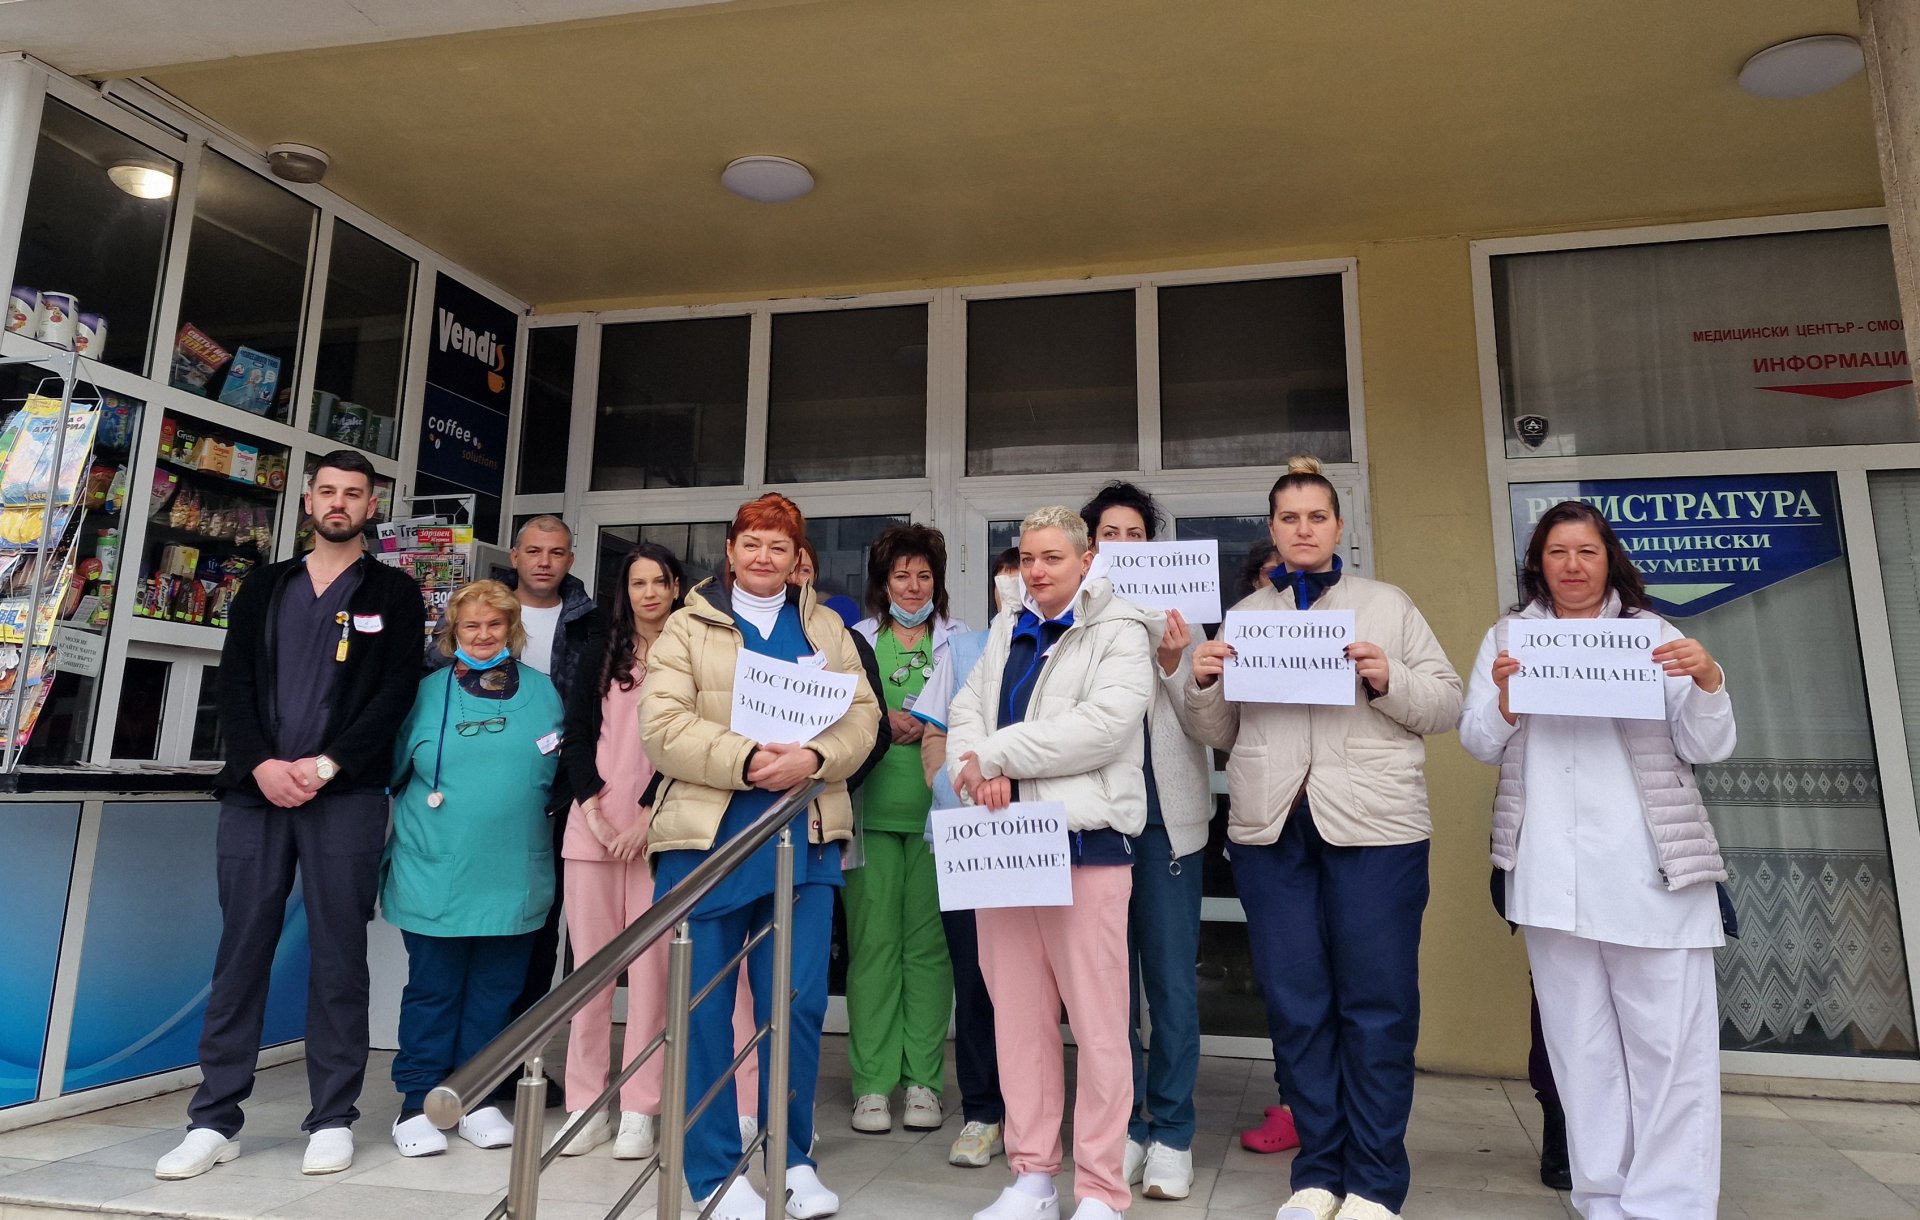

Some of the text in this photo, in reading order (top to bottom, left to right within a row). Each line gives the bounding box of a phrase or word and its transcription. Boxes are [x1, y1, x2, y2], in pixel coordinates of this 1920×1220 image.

[1693, 325, 1790, 343] МЕДИЦИНСКИ
[1753, 350, 1908, 373] ИНФОРМАЦИ
[428, 416, 471, 443] coffee
[461, 449, 499, 471] solutions
[1527, 489, 1822, 523] РИСТРАТУРА
[1619, 533, 1772, 553] ИЦИНСКИ
[1110, 552, 1211, 569] ДОСТОЙНО
[1630, 557, 1762, 573] КУМЕНТИ
[1235, 622, 1346, 640] ДОСТОЙНО
[1521, 631, 1651, 650] ДОСТОЙНО
[1232, 656, 1351, 671] ЗАПЛАЩАНЕ!
[1518, 665, 1657, 682] ЗАПЛАЩАНЕ!
[744, 666, 847, 700] ДОСТОЙНО
[945, 816, 1059, 844] ДОСТОЙНО
[944, 853, 1066, 875] ЗАПЛАЩАНЕ!
